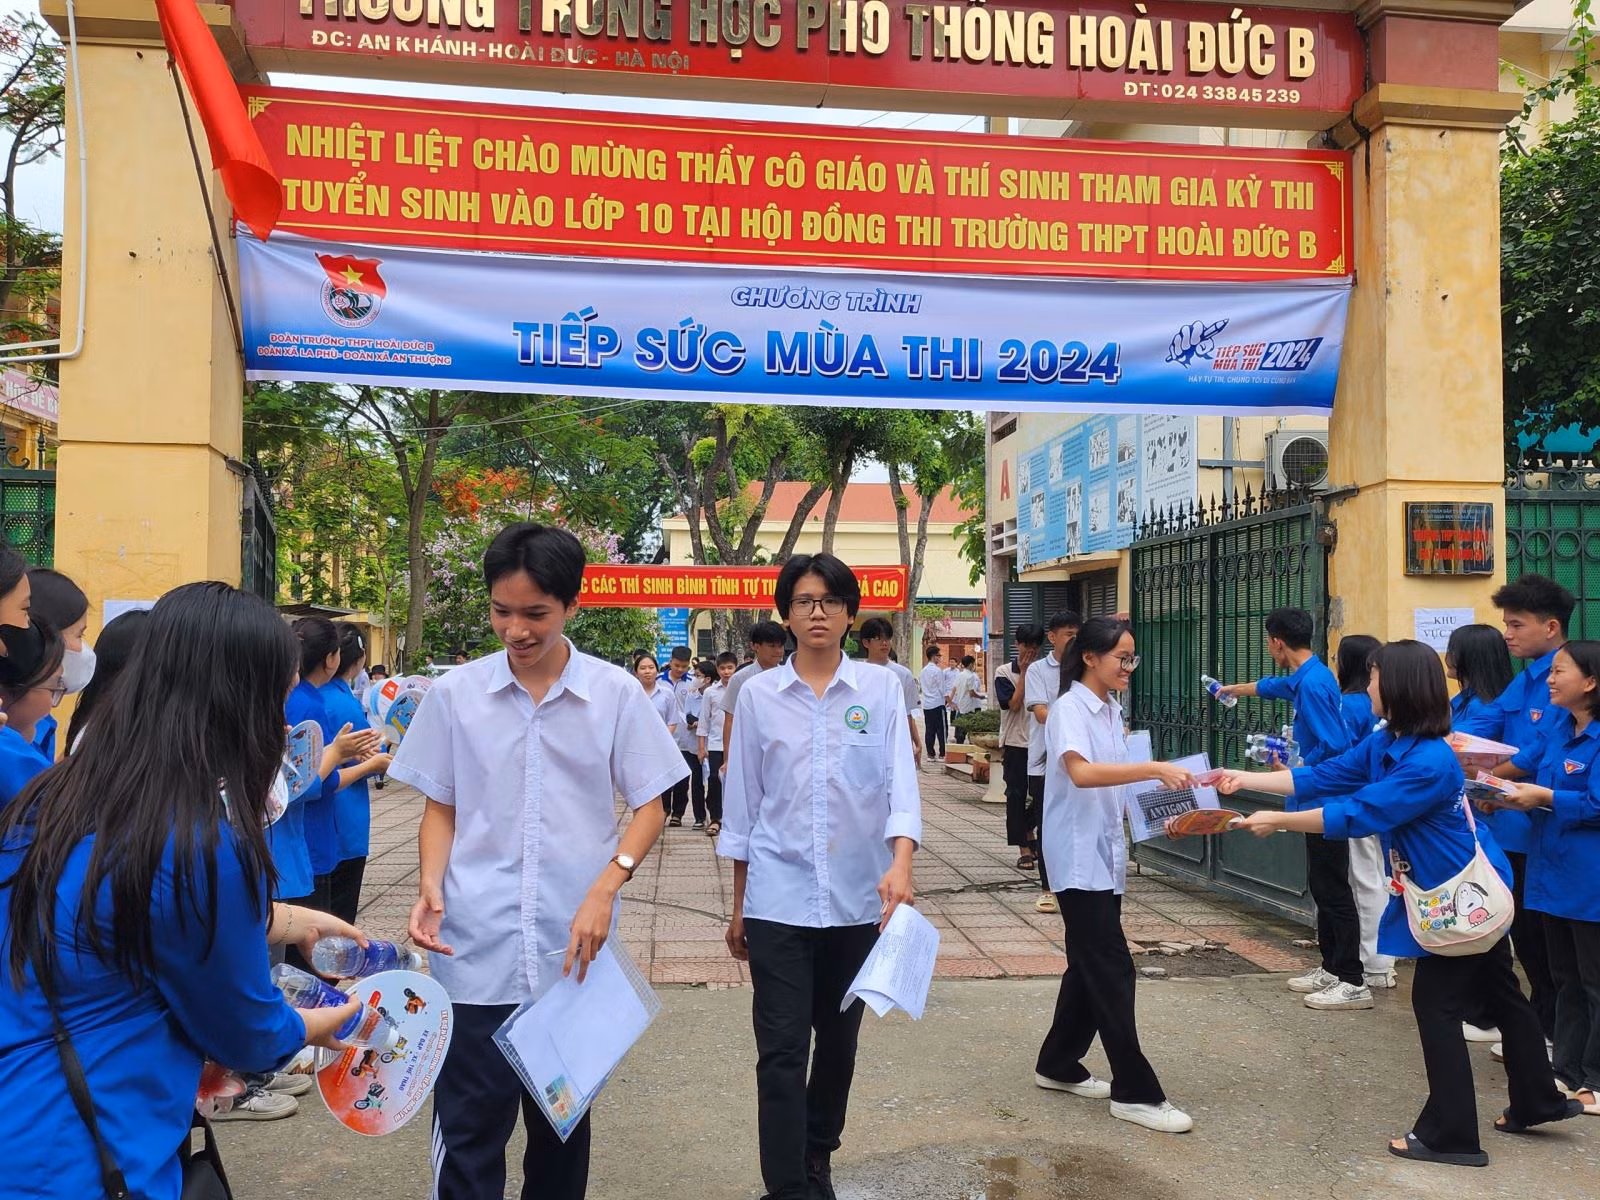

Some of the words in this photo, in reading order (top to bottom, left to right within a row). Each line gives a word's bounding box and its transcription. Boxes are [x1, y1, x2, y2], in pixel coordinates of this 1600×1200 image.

[312, 30, 352, 47] ĐC:
[358, 33, 391, 51] AN
[551, 45, 599, 65] ĐỨC
[615, 49, 646, 68] HÀ
[652, 50, 690, 75] NỘI
[1069, 3, 1174, 72] HOÀI
[1188, 8, 1276, 76] ĐỨC
[1289, 27, 1316, 78] B
[287, 122, 385, 167] NHIỆT
[396, 128, 463, 173] LIỆT
[473, 135, 560, 174] CHÀO
[571, 140, 667, 181] MỪNG
[677, 143, 755, 186] THẦY
[765, 151, 806, 188] CÔ
[816, 155, 887, 193] GIÁO
[896, 158, 935, 195] VÀ
[944, 161, 991, 197] THÍ
[999, 168, 1070, 201] SINH
[1079, 172, 1161, 205] THAM
[1170, 177, 1218, 207] GIA
[1227, 173, 1263, 209] KỲ
[1271, 180, 1314, 210] THI
[282, 170, 390, 217] TUYỂN
[400, 187, 480, 223] SINH
[491, 188, 555, 227] VÀO
[565, 192, 625, 231] LỚP
[636, 202, 673, 234] 10
[682, 204, 731, 244] TẠI
[741, 202, 792, 246] HỘI
[801, 201, 886, 244] ĐỒNG
[896, 215, 942, 247] THI
[951, 212, 1069, 252] TRƯỜNG
[1077, 223, 1149, 254] THPT
[1157, 221, 1224, 257] HOÀI
[1232, 223, 1290, 259] ĐỨC
[1299, 230, 1317, 259] B
[731, 284, 841, 310] CHƯƠNG
[846, 287, 923, 314] TRÌNH
[258, 345, 282, 356] ĐOÀN
[283, 345, 299, 357] XÃ
[300, 348, 315, 358] LA
[343, 349, 374, 361] ĐOÀN
[375, 351, 390, 361] XÃ
[391, 352, 407, 363] AN
[408, 354, 452, 366] THƯỢNG
[270, 332, 300, 344] ĐOÀN
[301, 335, 345, 347] TRƯỜNG
[347, 338, 374, 349] THPT
[375, 338, 400, 349] HOÀI
[402, 340, 425, 351] ĐỨC
[426, 341, 435, 352] B
[511, 305, 622, 368] TIẾP
[633, 316, 746, 375] SỨC
[764, 319, 889, 377] MÙA
[902, 335, 983, 380] THI
[997, 338, 1121, 384] 2024
[1262, 338, 1317, 369] 2024
[1000, 458, 1011, 501] A
[591, 574, 617, 594] CÁC
[619, 574, 640, 594] THÍ
[643, 576, 674, 595] SINH
[676, 575, 707, 595] BÌNH
[710, 575, 740, 596] TĨNH
[743, 576, 761, 599] TỰ
[873, 579, 899, 598] CAO
[1433, 616, 1457, 625] KHU
[1150, 801, 1194, 819] ANTIGONE
[1421, 916, 1457, 931] NOM
